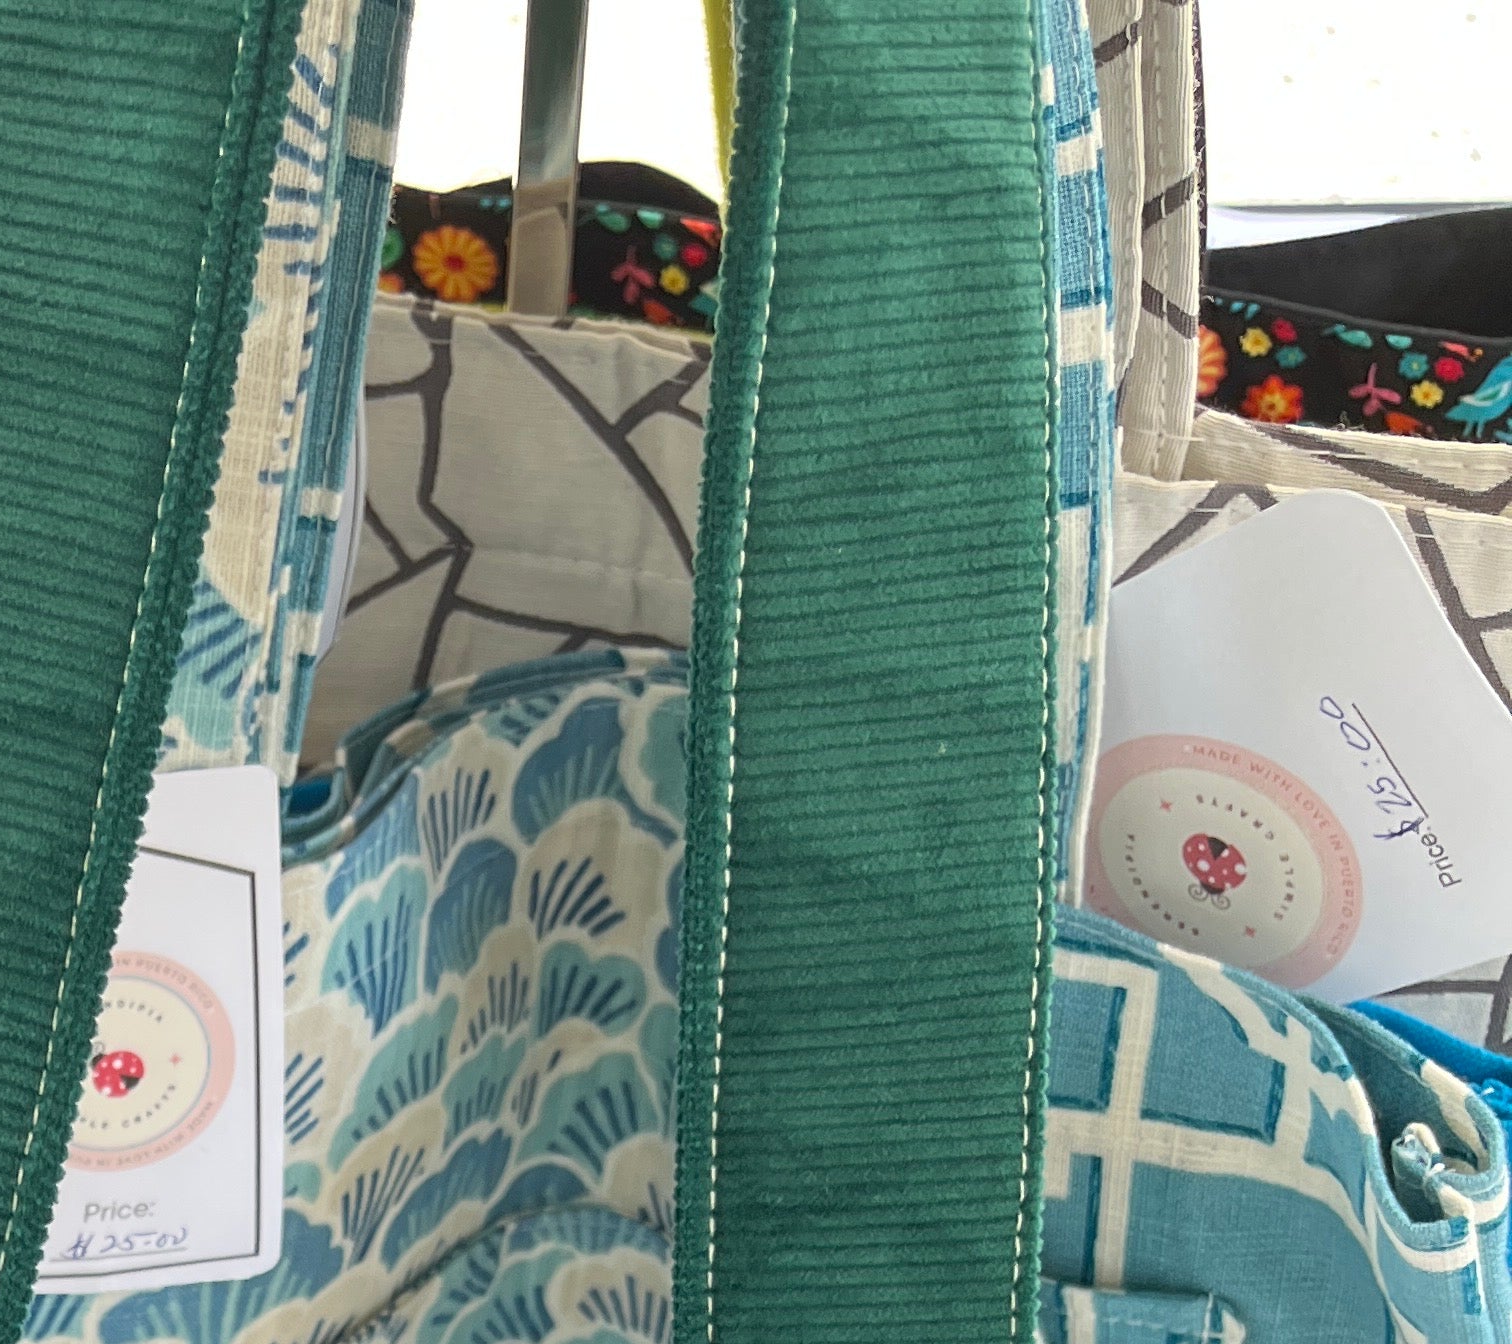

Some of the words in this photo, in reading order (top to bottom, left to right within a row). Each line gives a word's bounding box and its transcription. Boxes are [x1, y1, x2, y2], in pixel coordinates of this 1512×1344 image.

[1192, 745, 1239, 765] MADE
[1249, 760, 1292, 791] WITH
[1294, 786, 1331, 829] LOVE
[1330, 833, 1344, 851] IN
[83, 1200, 157, 1223] Price:
